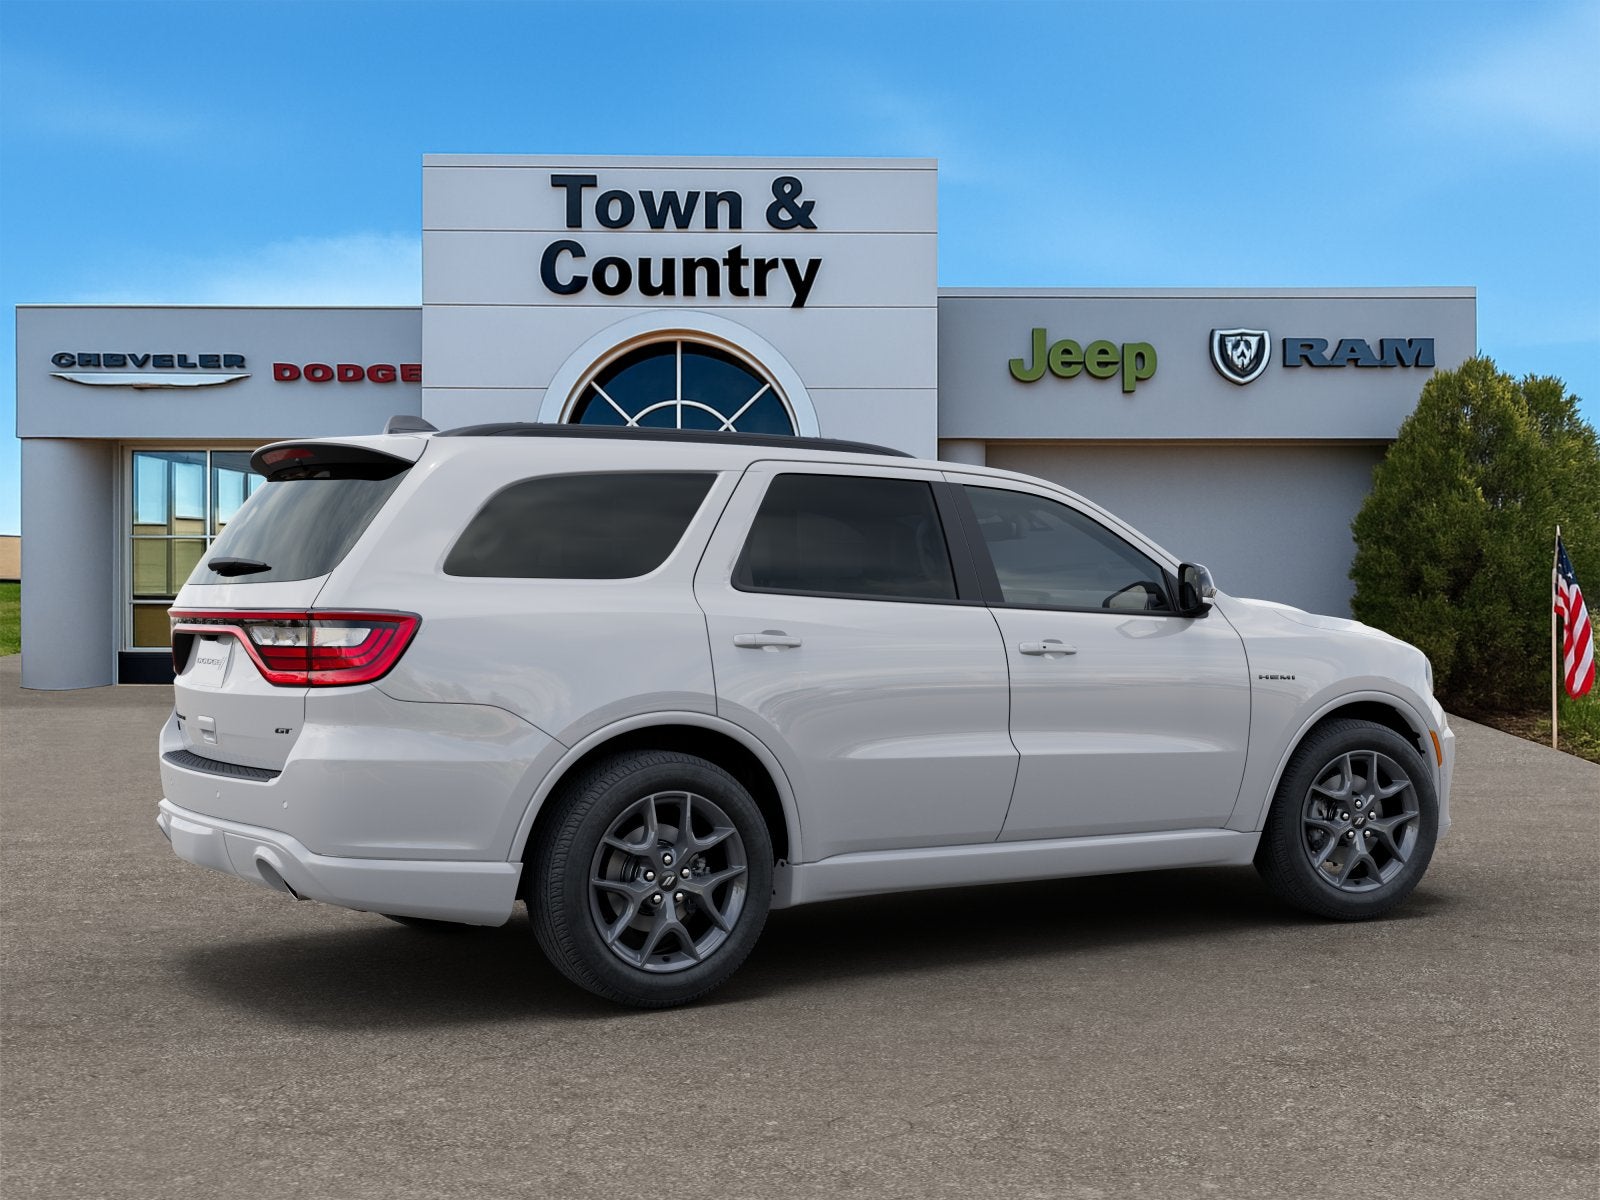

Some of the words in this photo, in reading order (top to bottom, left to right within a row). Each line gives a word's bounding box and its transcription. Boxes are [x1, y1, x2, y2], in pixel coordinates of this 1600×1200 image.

[550, 174, 742, 229] Town
[765, 176, 818, 230] &
[540, 239, 822, 308] Country
[273, 362, 422, 383] DODGE
[1008, 327, 1158, 393] Jeep
[1282, 337, 1435, 367] RAM
[274, 727, 293, 735] GT
